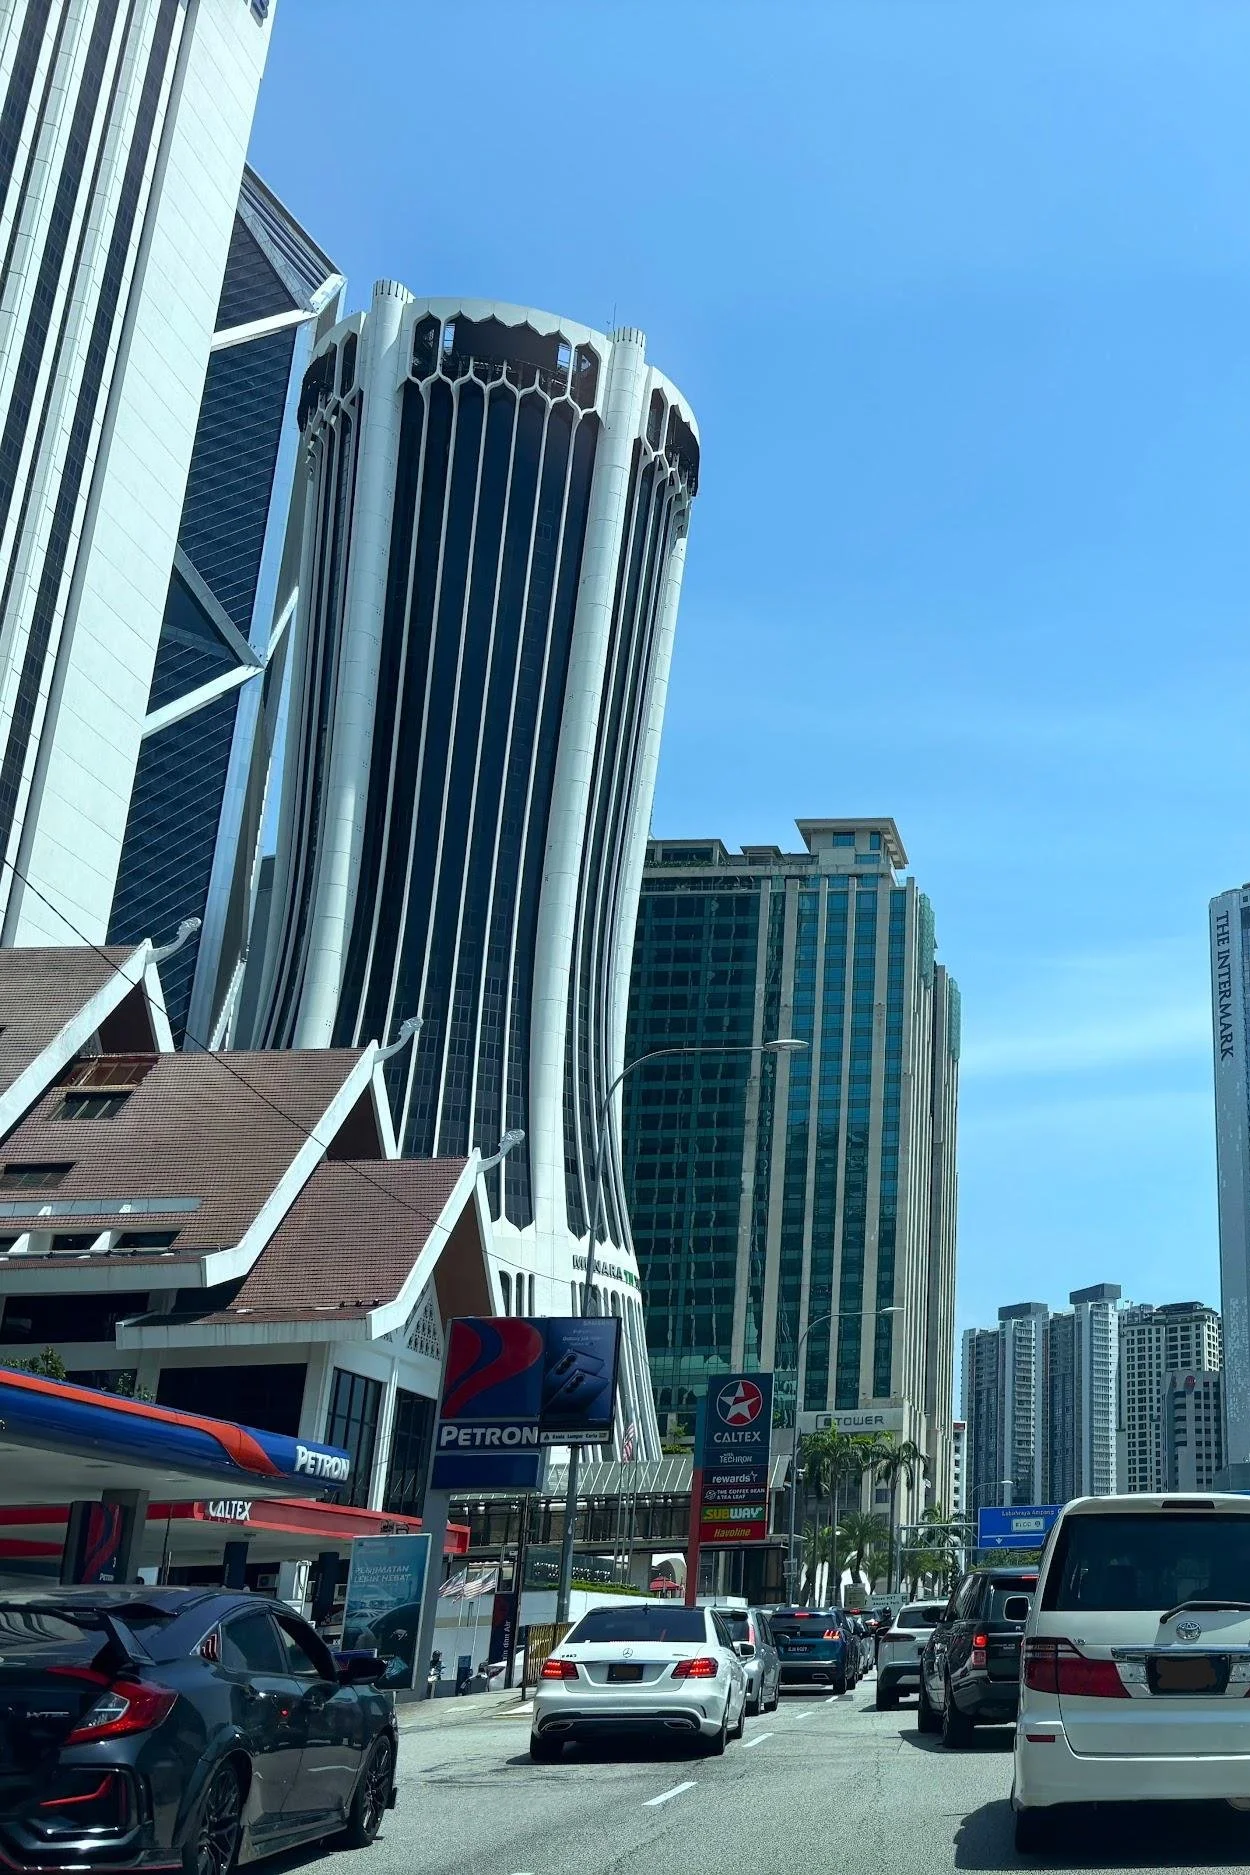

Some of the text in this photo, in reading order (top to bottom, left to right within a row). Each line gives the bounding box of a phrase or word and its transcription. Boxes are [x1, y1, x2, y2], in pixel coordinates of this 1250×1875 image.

[1216, 910, 1234, 1061] THE INTERMARK
[835, 1415, 885, 1426] TOWER
[440, 1426, 539, 1447] PETRON
[713, 1431, 761, 1443] CALTEX
[293, 1445, 350, 1481] PETRON
[720, 1455, 752, 1464] TECHRON
[712, 1474, 751, 1483] rewards
[209, 1500, 252, 1521] CALTEX
[704, 1506, 763, 1520] SUBWAY
[714, 1527, 752, 1538] Havoline
